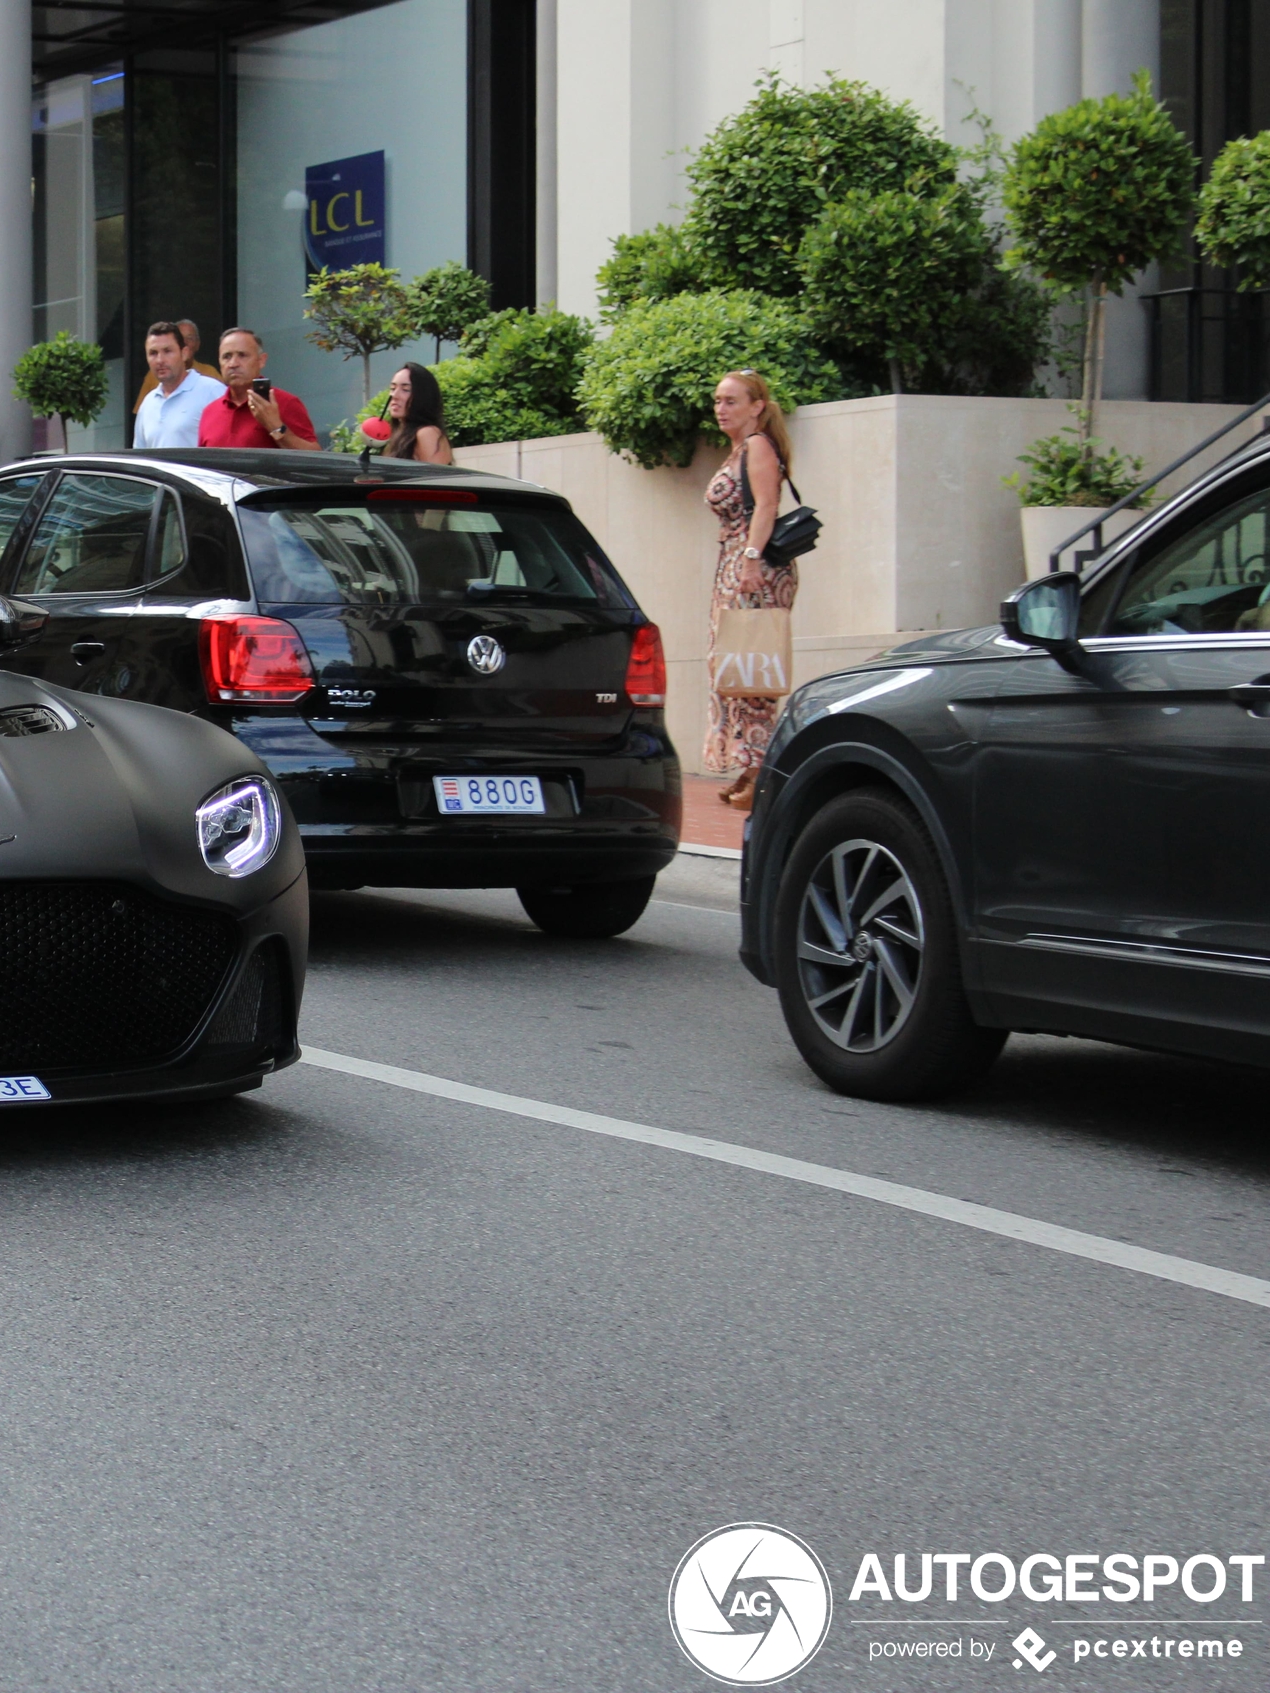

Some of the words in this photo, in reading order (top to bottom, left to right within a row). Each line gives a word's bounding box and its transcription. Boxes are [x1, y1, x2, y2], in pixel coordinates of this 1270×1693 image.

[311, 190, 375, 235] LCL
[713, 652, 787, 688] ZARA
[327, 689, 376, 700] POLO
[595, 693, 617, 703] TDI
[468, 779, 535, 805] 880G
